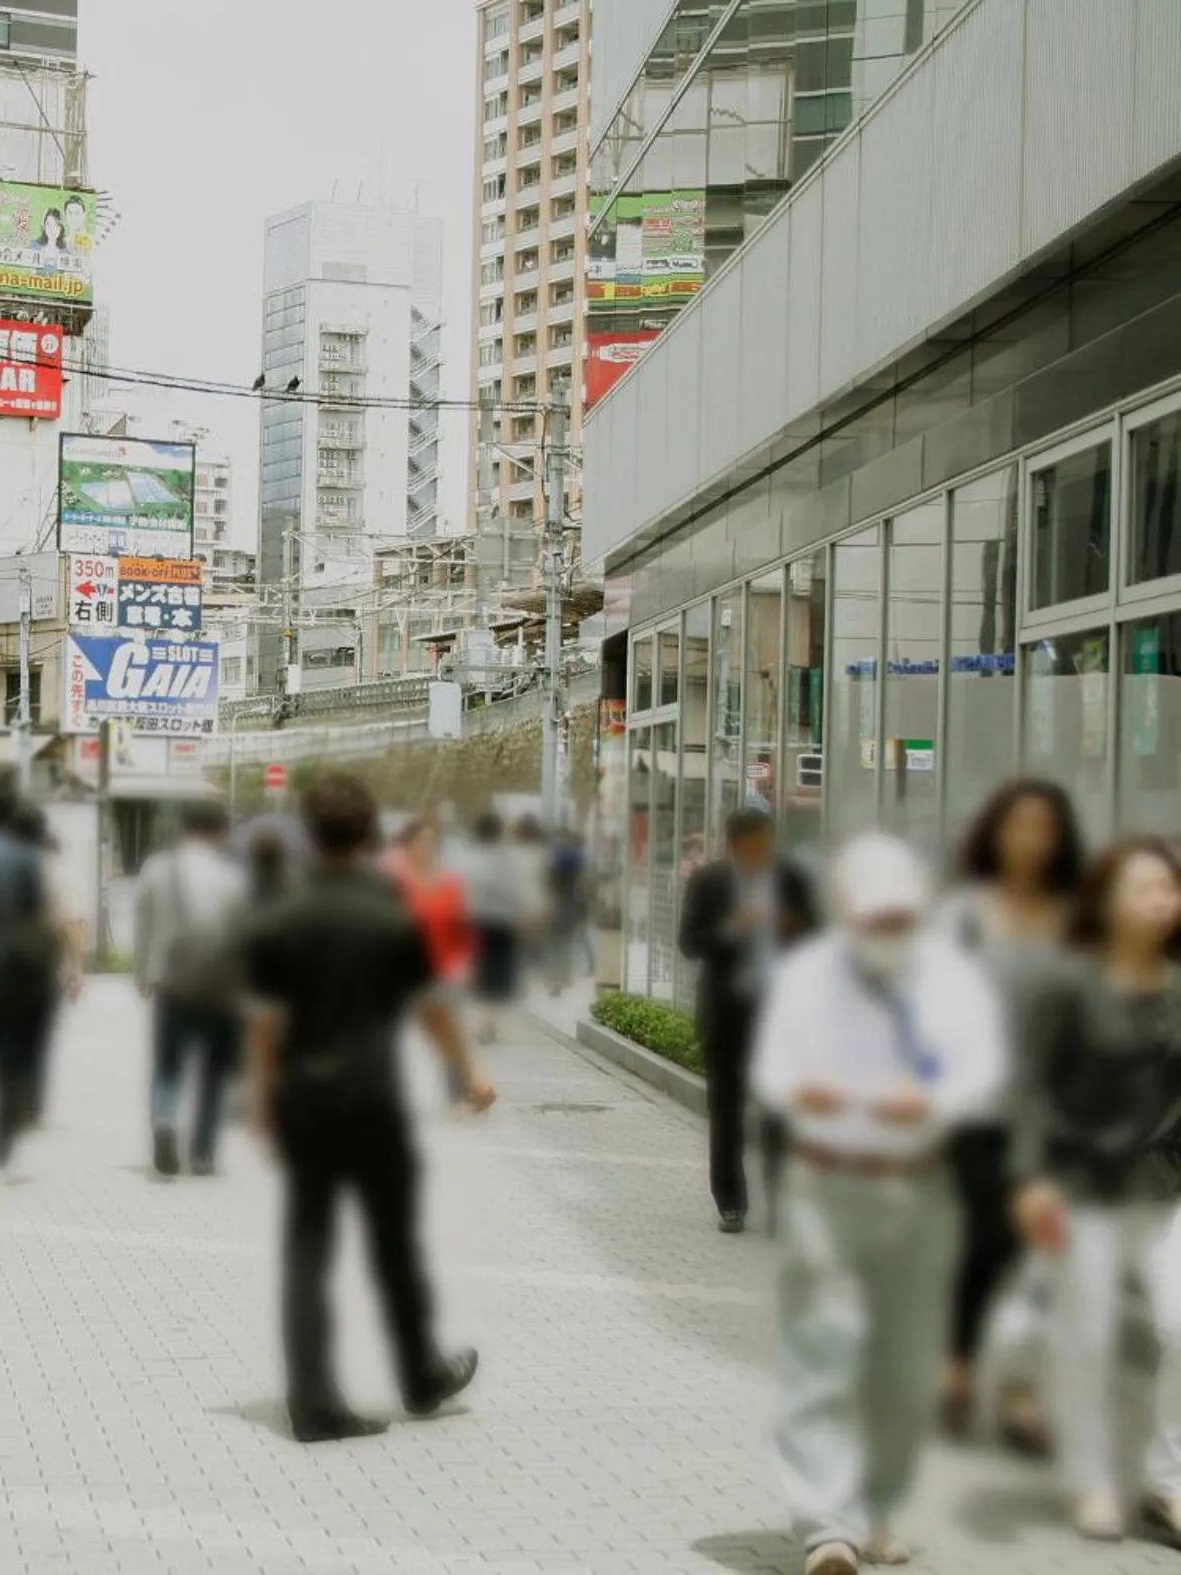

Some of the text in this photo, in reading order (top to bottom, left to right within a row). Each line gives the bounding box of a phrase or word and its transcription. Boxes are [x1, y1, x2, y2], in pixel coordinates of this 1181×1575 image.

[74, 560, 115, 578] 350m
[74, 600, 114, 622] 右側
[168, 645, 200, 662] SLOT
[106, 641, 213, 699] GAIA
